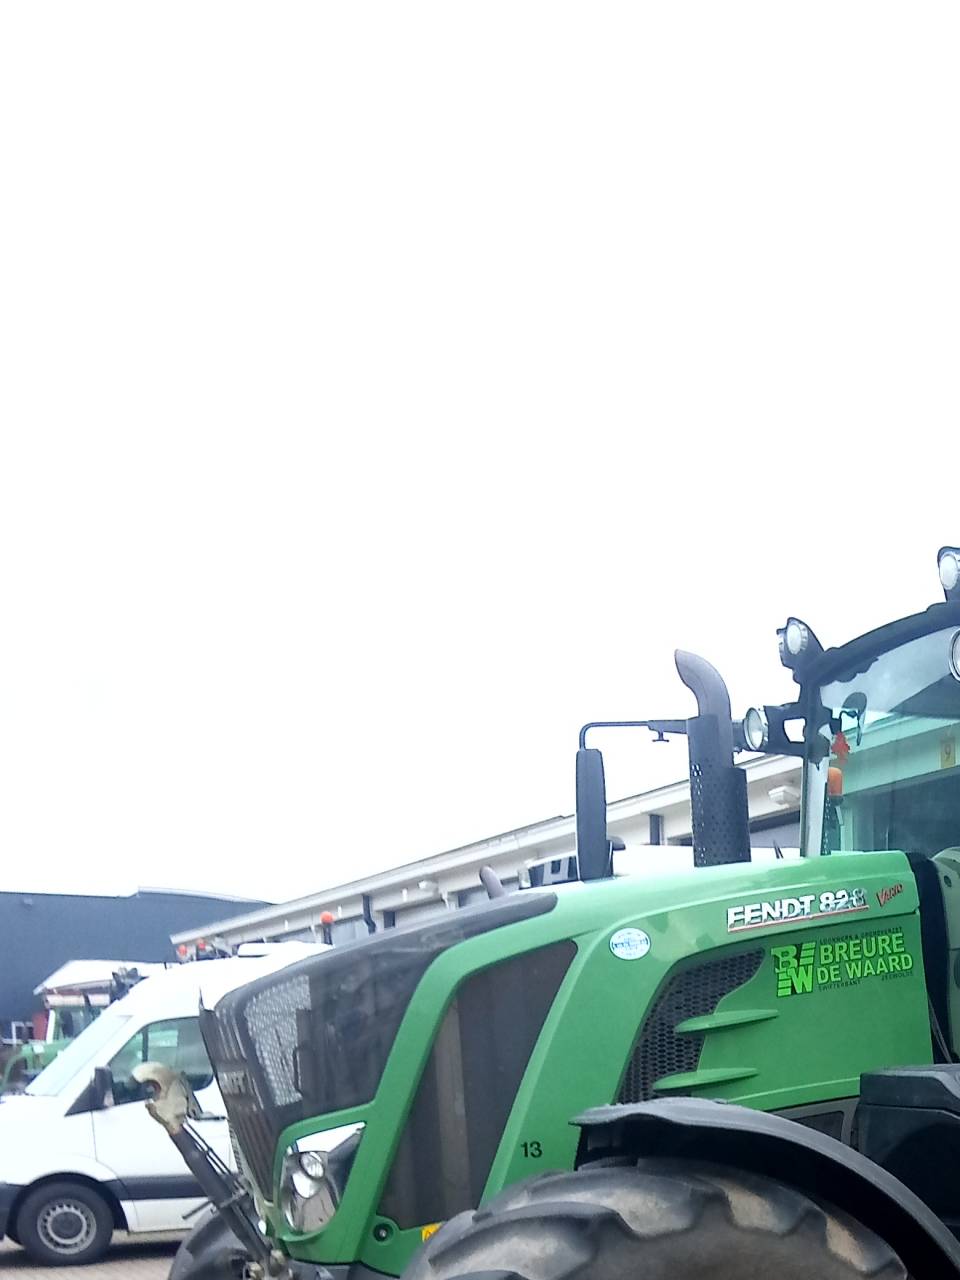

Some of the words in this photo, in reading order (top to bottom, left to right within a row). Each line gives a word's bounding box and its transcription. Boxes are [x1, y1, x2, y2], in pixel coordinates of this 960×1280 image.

[727, 894, 815, 929] FENDT
[819, 931, 905, 965] BREURE
[816, 964, 842, 985] DE
[845, 952, 914, 980] WAARD
[520, 1141, 543, 1159] 13
